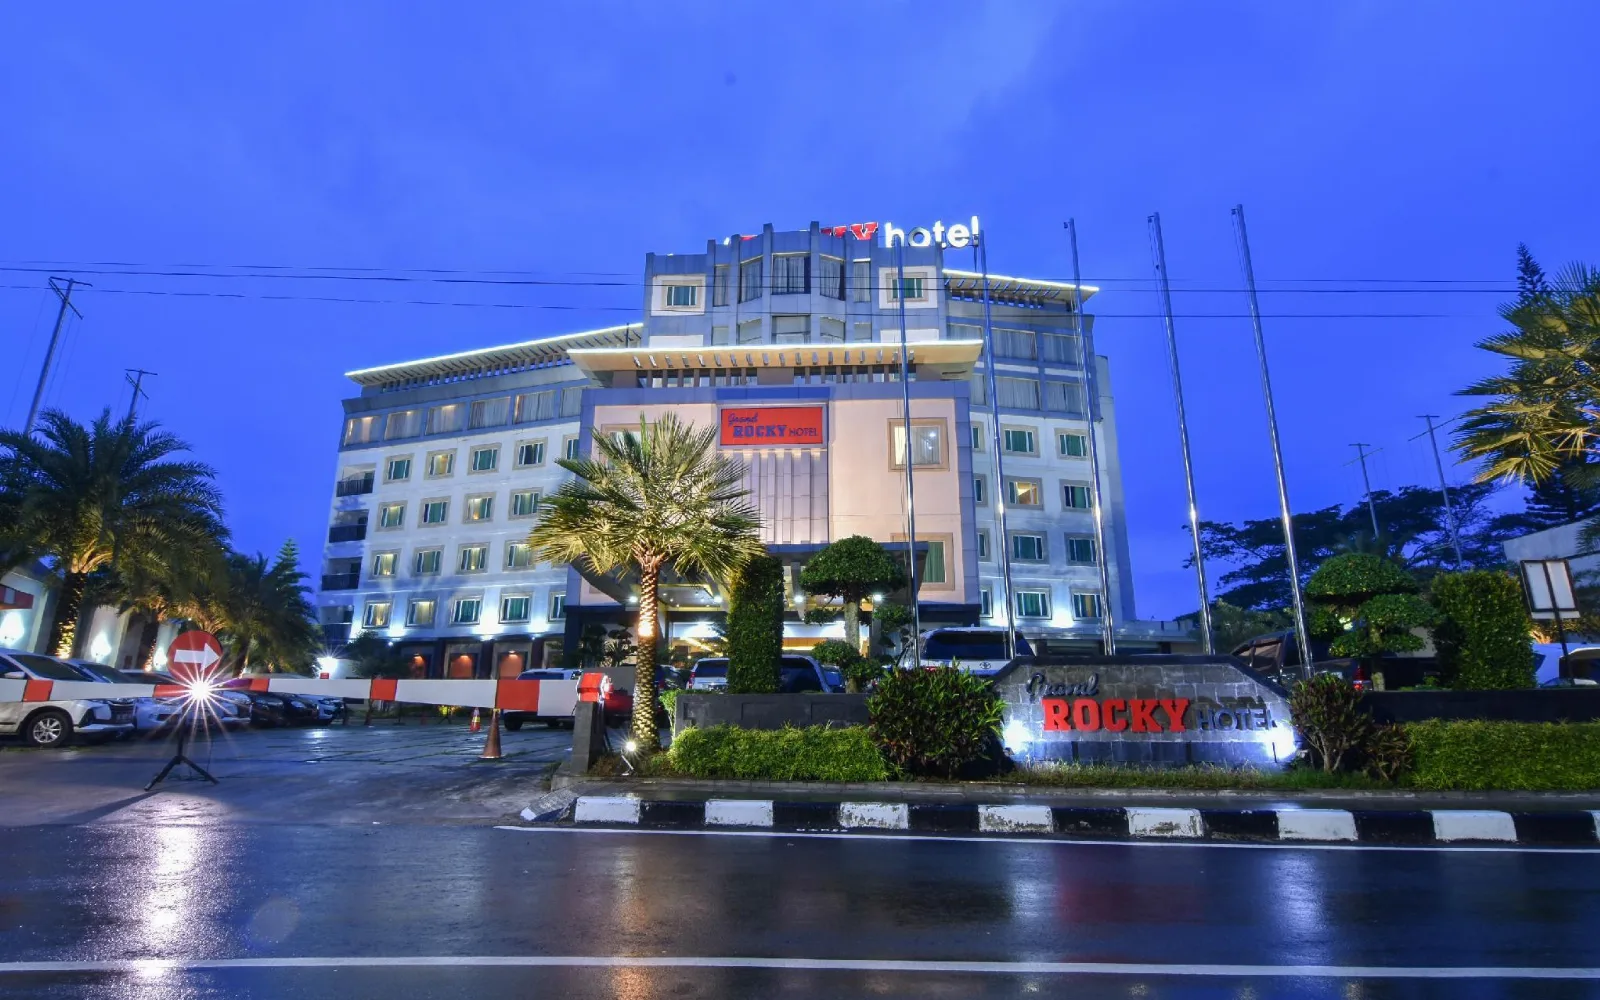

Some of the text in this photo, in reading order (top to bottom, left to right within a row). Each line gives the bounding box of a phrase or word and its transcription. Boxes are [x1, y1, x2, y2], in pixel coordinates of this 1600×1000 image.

[884, 215, 979, 250] hotel
[728, 413, 758, 426] Grand
[733, 425, 817, 437] ROCKY HOTEL
[1026, 672, 1099, 703] Grand
[1042, 697, 1277, 732] ROCKY HOTEL
